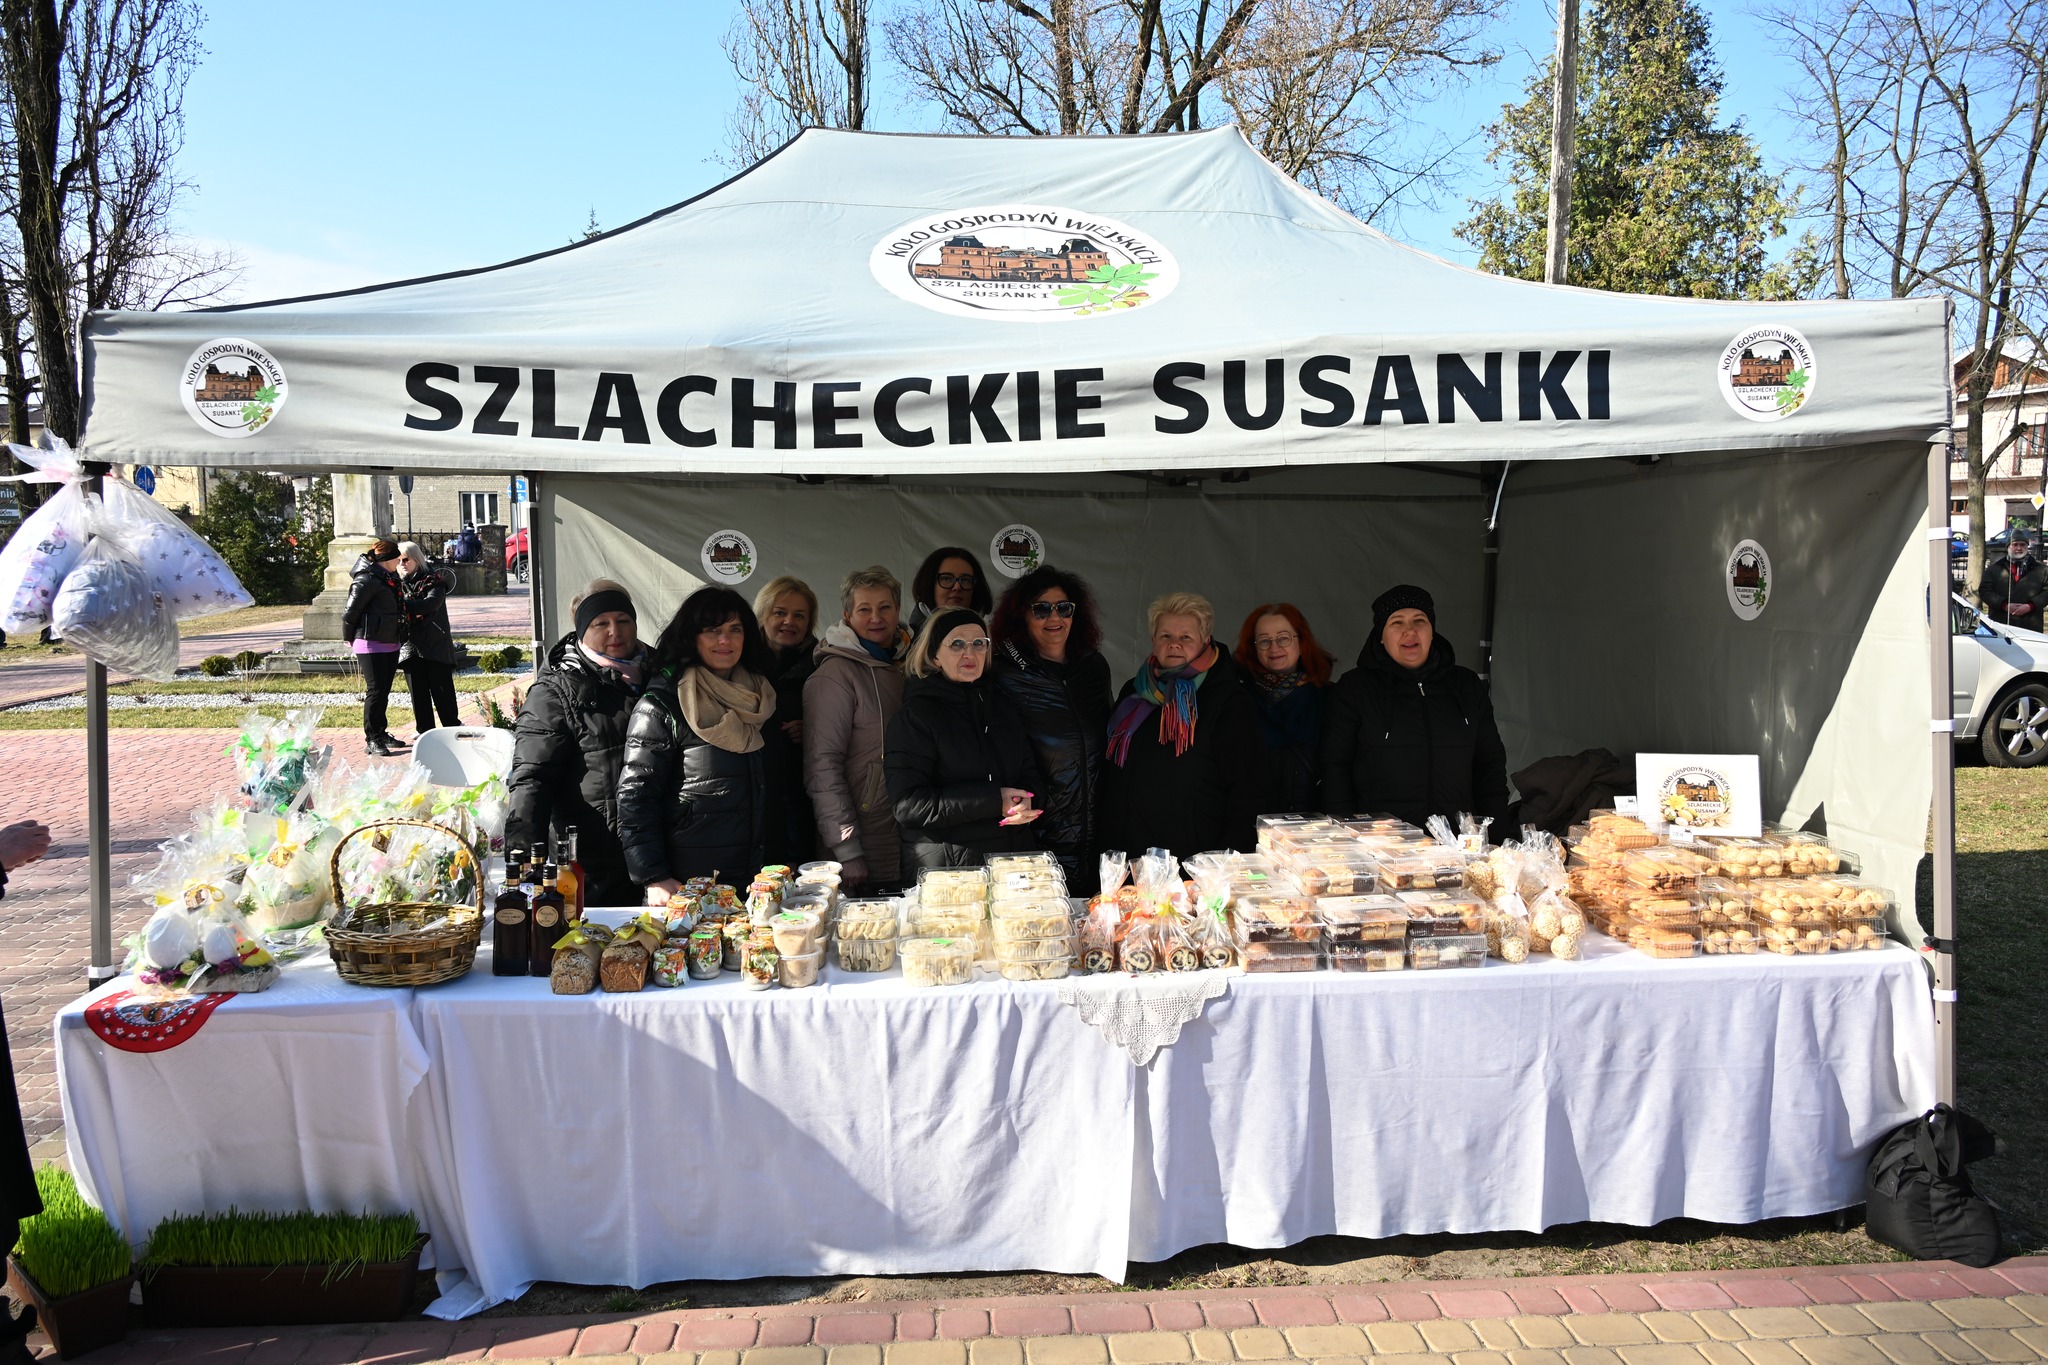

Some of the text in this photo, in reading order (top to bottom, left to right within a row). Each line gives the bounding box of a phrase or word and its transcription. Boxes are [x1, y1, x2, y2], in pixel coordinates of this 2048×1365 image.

[885, 211, 1162, 266] KOŁO GOSPODYŃ WIEJSKICH
[931, 280, 1067, 290] SZLACHECKIE
[963, 290, 1049, 299] SUSANKI
[185, 344, 283, 386] KOŁO GOSPODYŃ WIEJSKICH
[1722, 328, 1812, 371] KOŁO GOSPODYŃ WIEJSKICH
[403, 350, 1611, 449] SZLACHECKIE SUSANKI
[1662, 765, 1731, 790] KOŁO GOSPODYŃ WIEJSKICH
